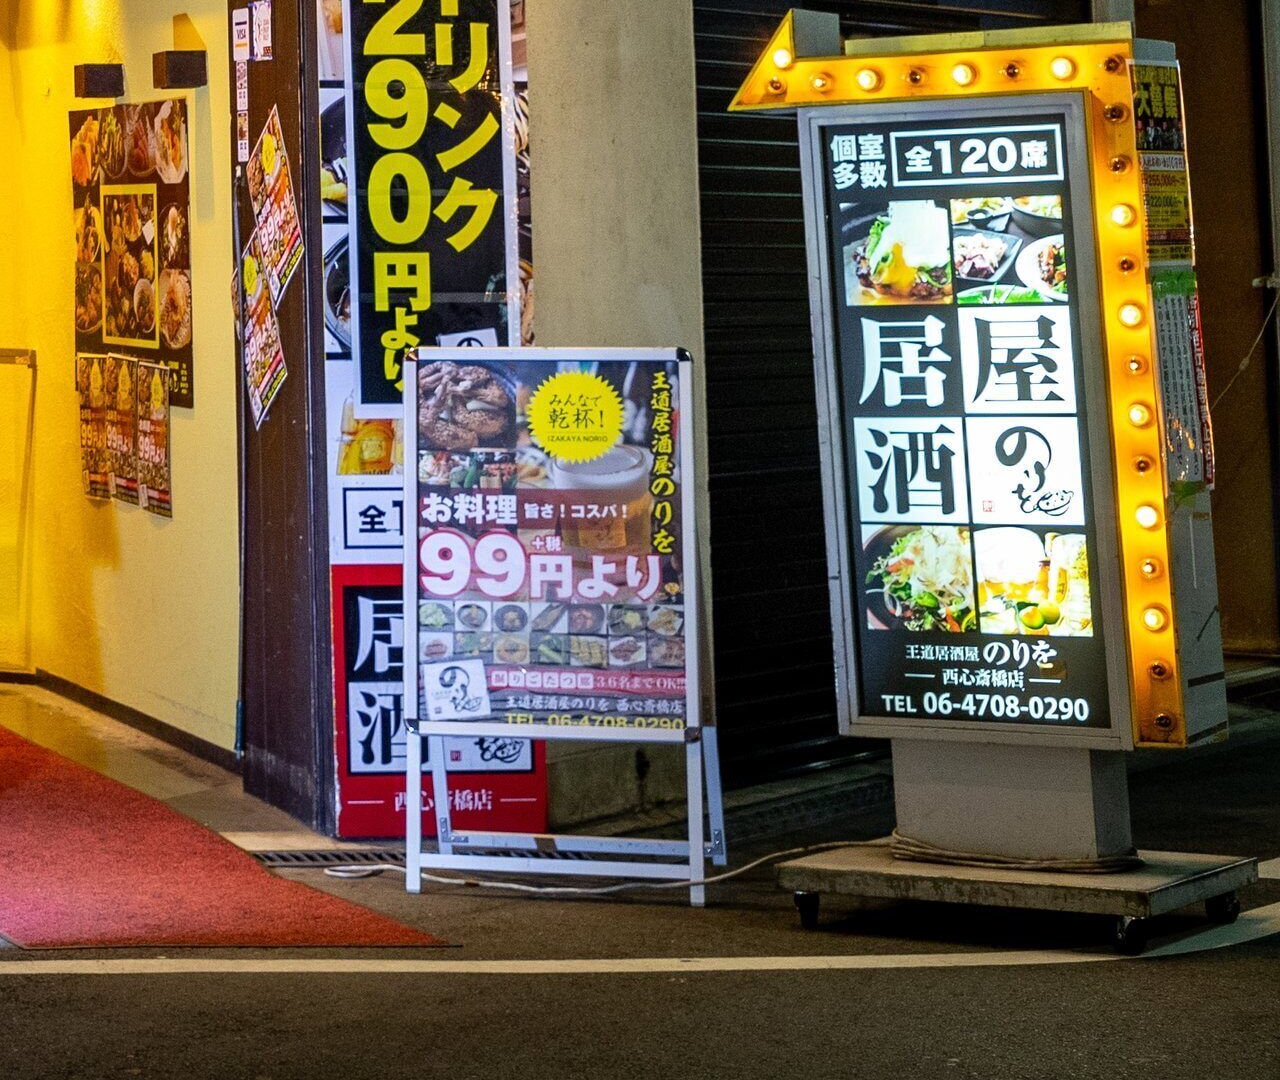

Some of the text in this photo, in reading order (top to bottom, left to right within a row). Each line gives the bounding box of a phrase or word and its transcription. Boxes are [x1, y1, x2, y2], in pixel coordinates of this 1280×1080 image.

[830, 133, 886, 163] 個室
[904, 136, 1048, 175] 全120席
[833, 161, 888, 190] 多数
[859, 313, 951, 409] 居
[973, 316, 1072, 404] 屋
[548, 394, 602, 407] みんなで
[547, 434, 608, 443] IZAKAYA NORIO
[650, 370, 676, 554] 王道居酒屋のりを
[865, 426, 956, 517] 酒
[995, 426, 1074, 516] のりを
[419, 492, 518, 526] お料理
[418, 529, 663, 601] 99円より
[905, 639, 1058, 669] 王道居酒屋 のりを
[942, 668, 1025, 688] 西心斎橋店
[505, 696, 685, 714] 王道居酒屋のりを 西心斎橋店
[881, 692, 1089, 722] TEL 06-4708-0290
